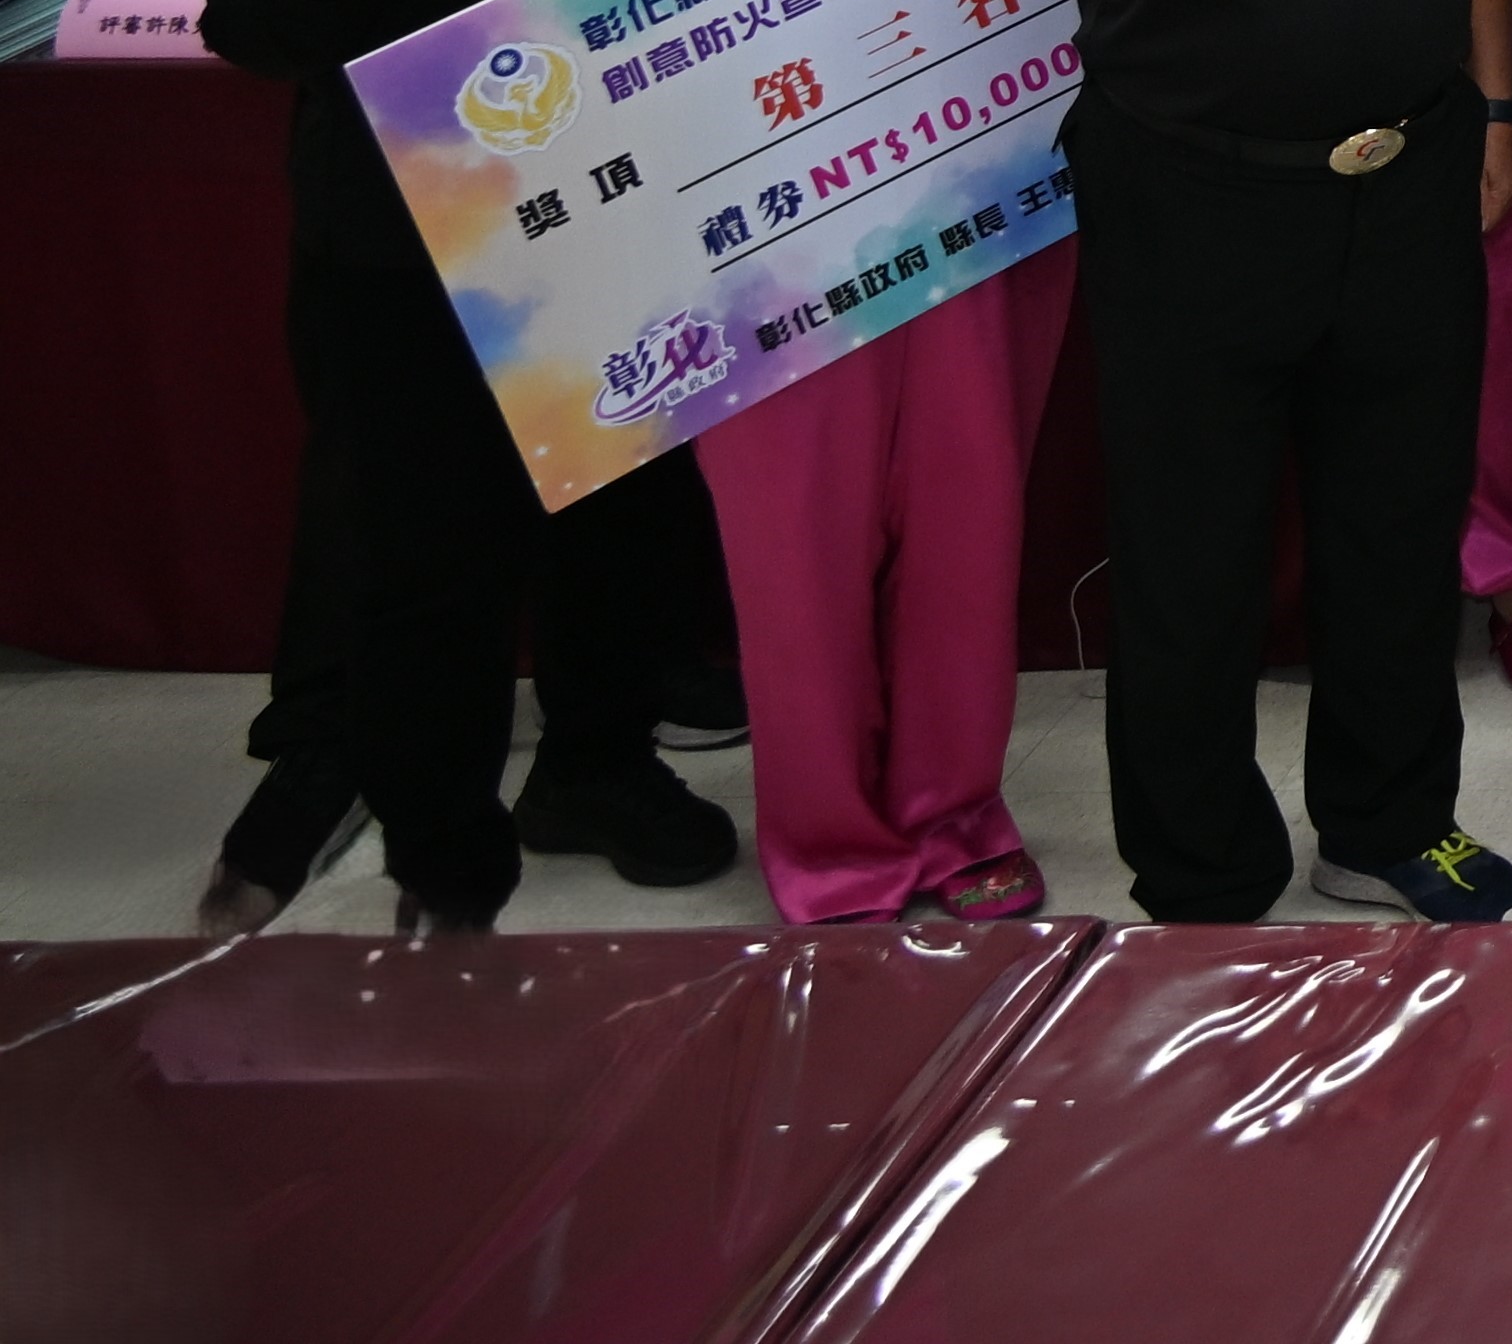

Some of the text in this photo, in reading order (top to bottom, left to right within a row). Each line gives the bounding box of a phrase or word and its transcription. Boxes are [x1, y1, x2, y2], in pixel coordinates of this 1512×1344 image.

[809, 43, 1081, 200] NT$10,000
[757, 247, 929, 353] 彰化縣政府
[941, 205, 1008, 258] 縣長
